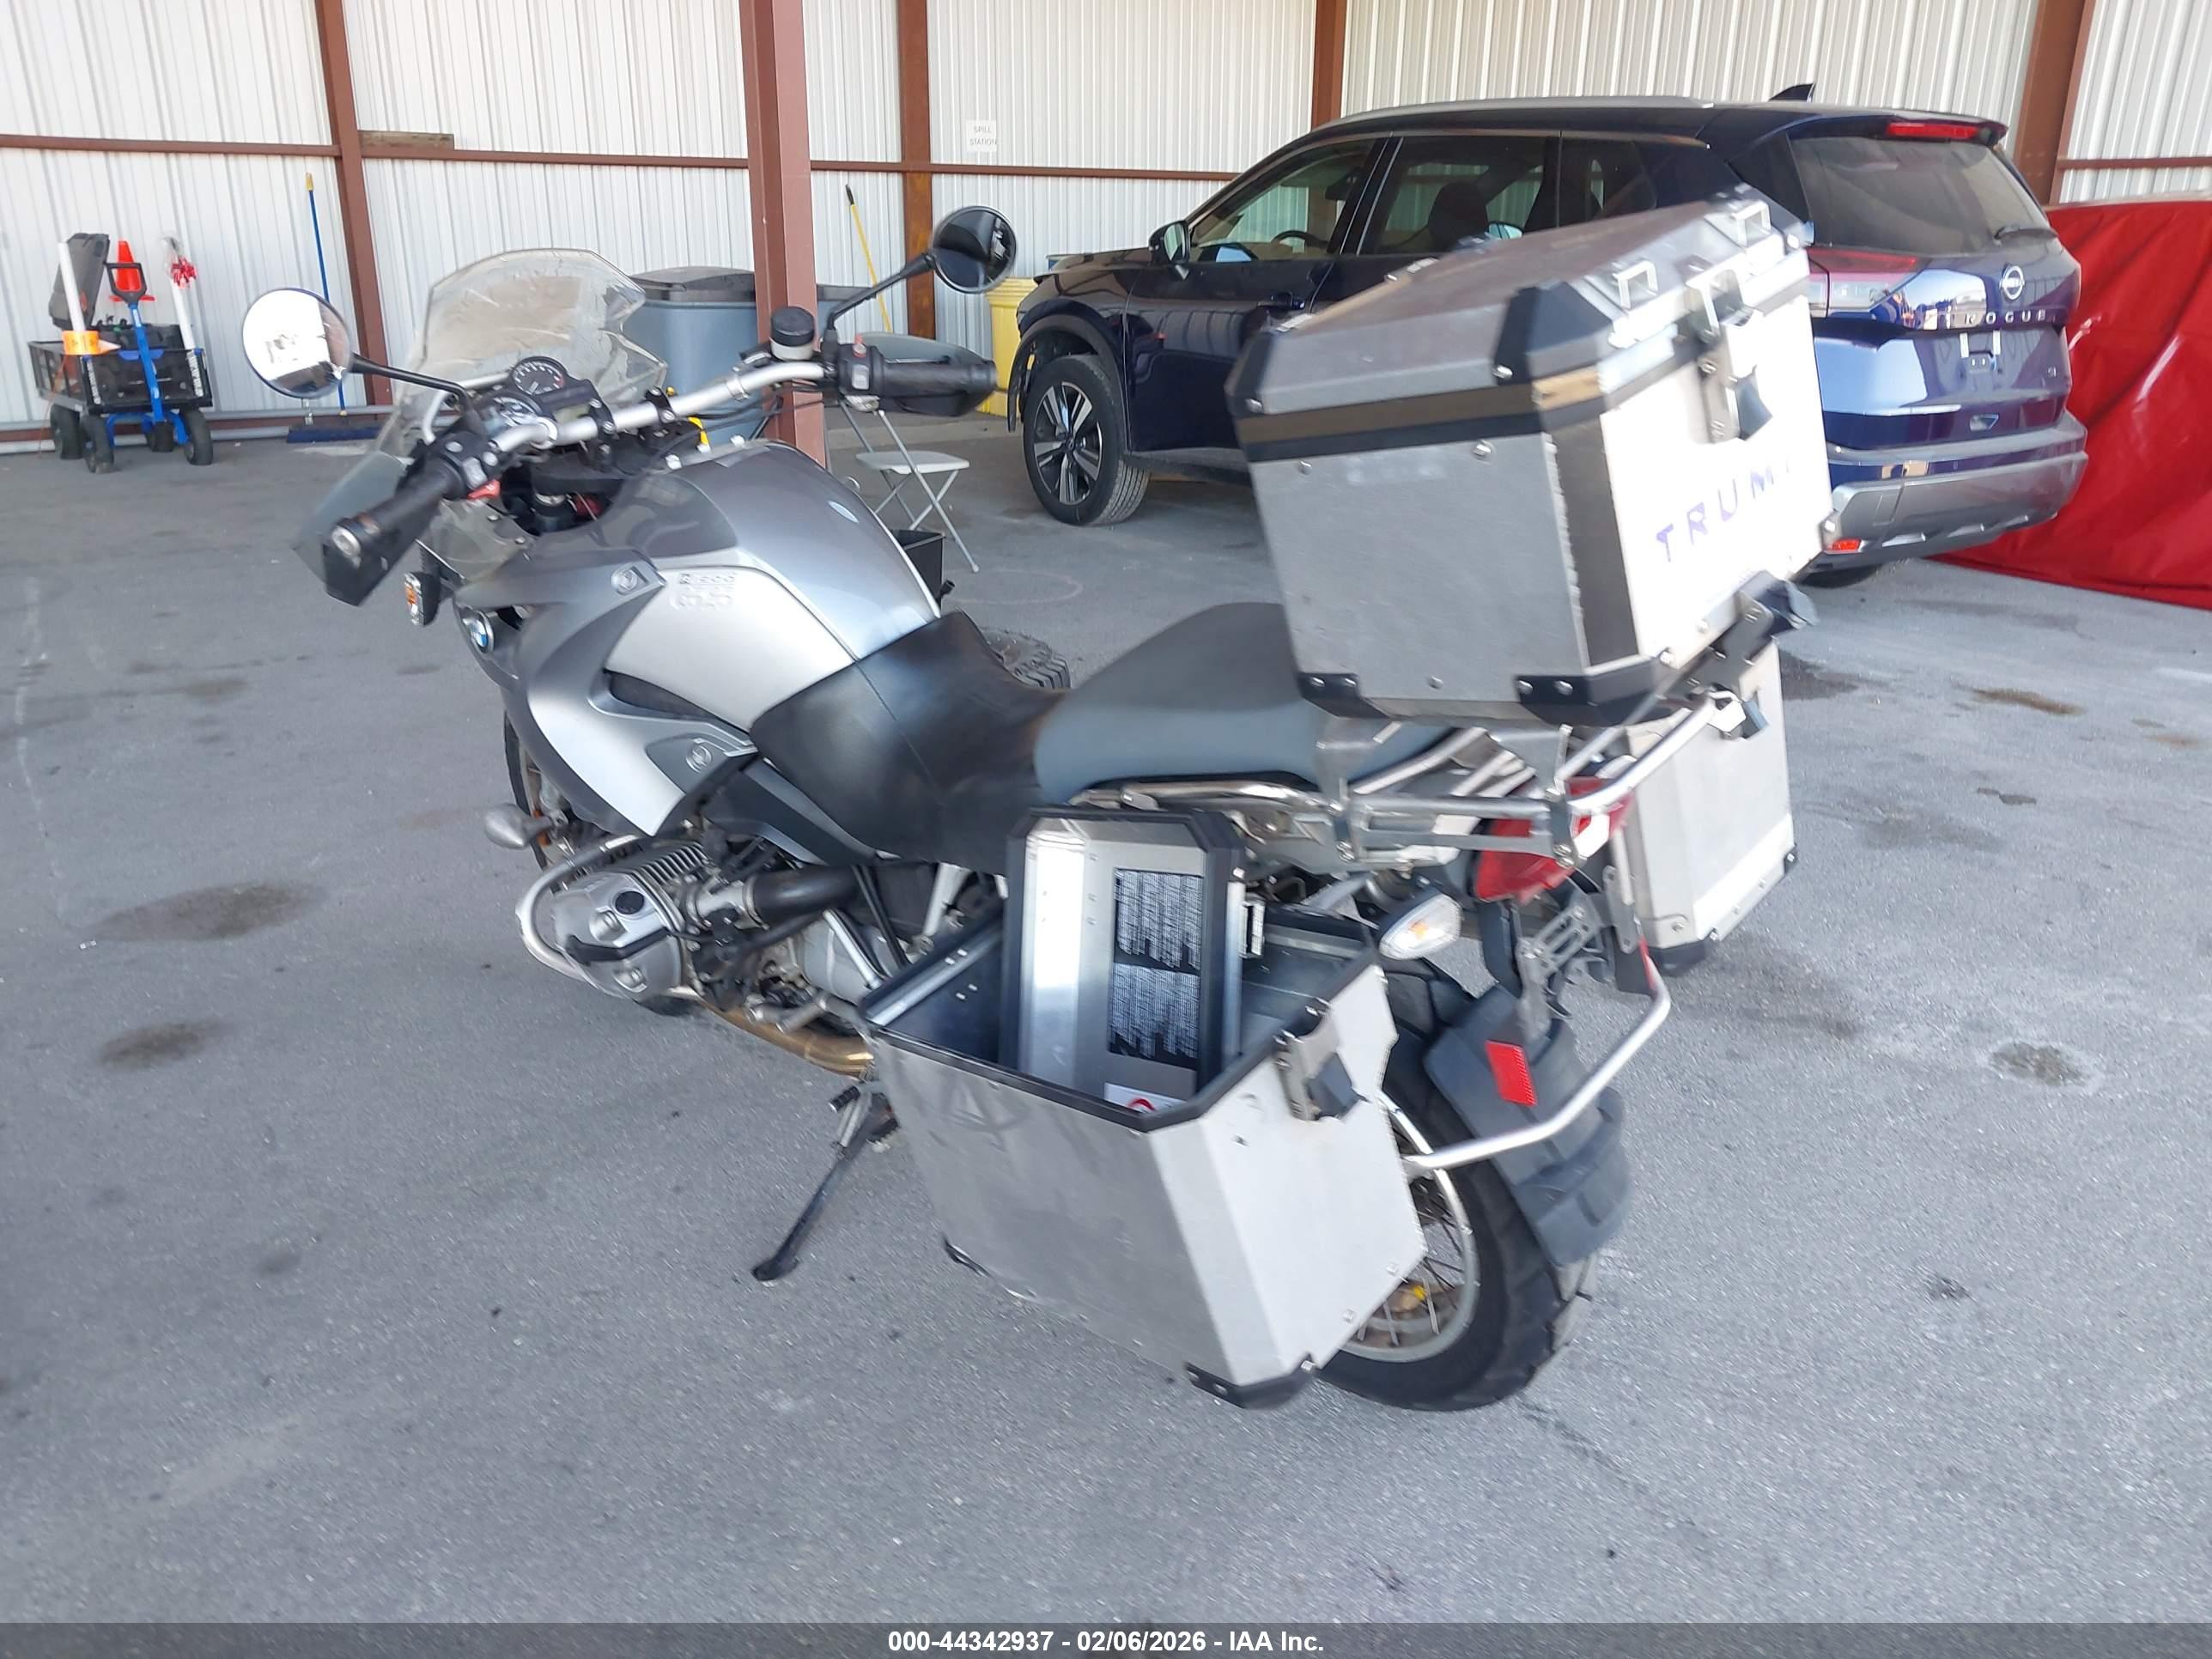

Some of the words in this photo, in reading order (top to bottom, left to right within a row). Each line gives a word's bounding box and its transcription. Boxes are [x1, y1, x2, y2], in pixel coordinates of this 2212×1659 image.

[973, 125, 992, 133] SPILL
[969, 137, 997, 146] STATION
[1965, 309, 2046, 325] ROGUE
[1656, 455, 1790, 562] TRUM
